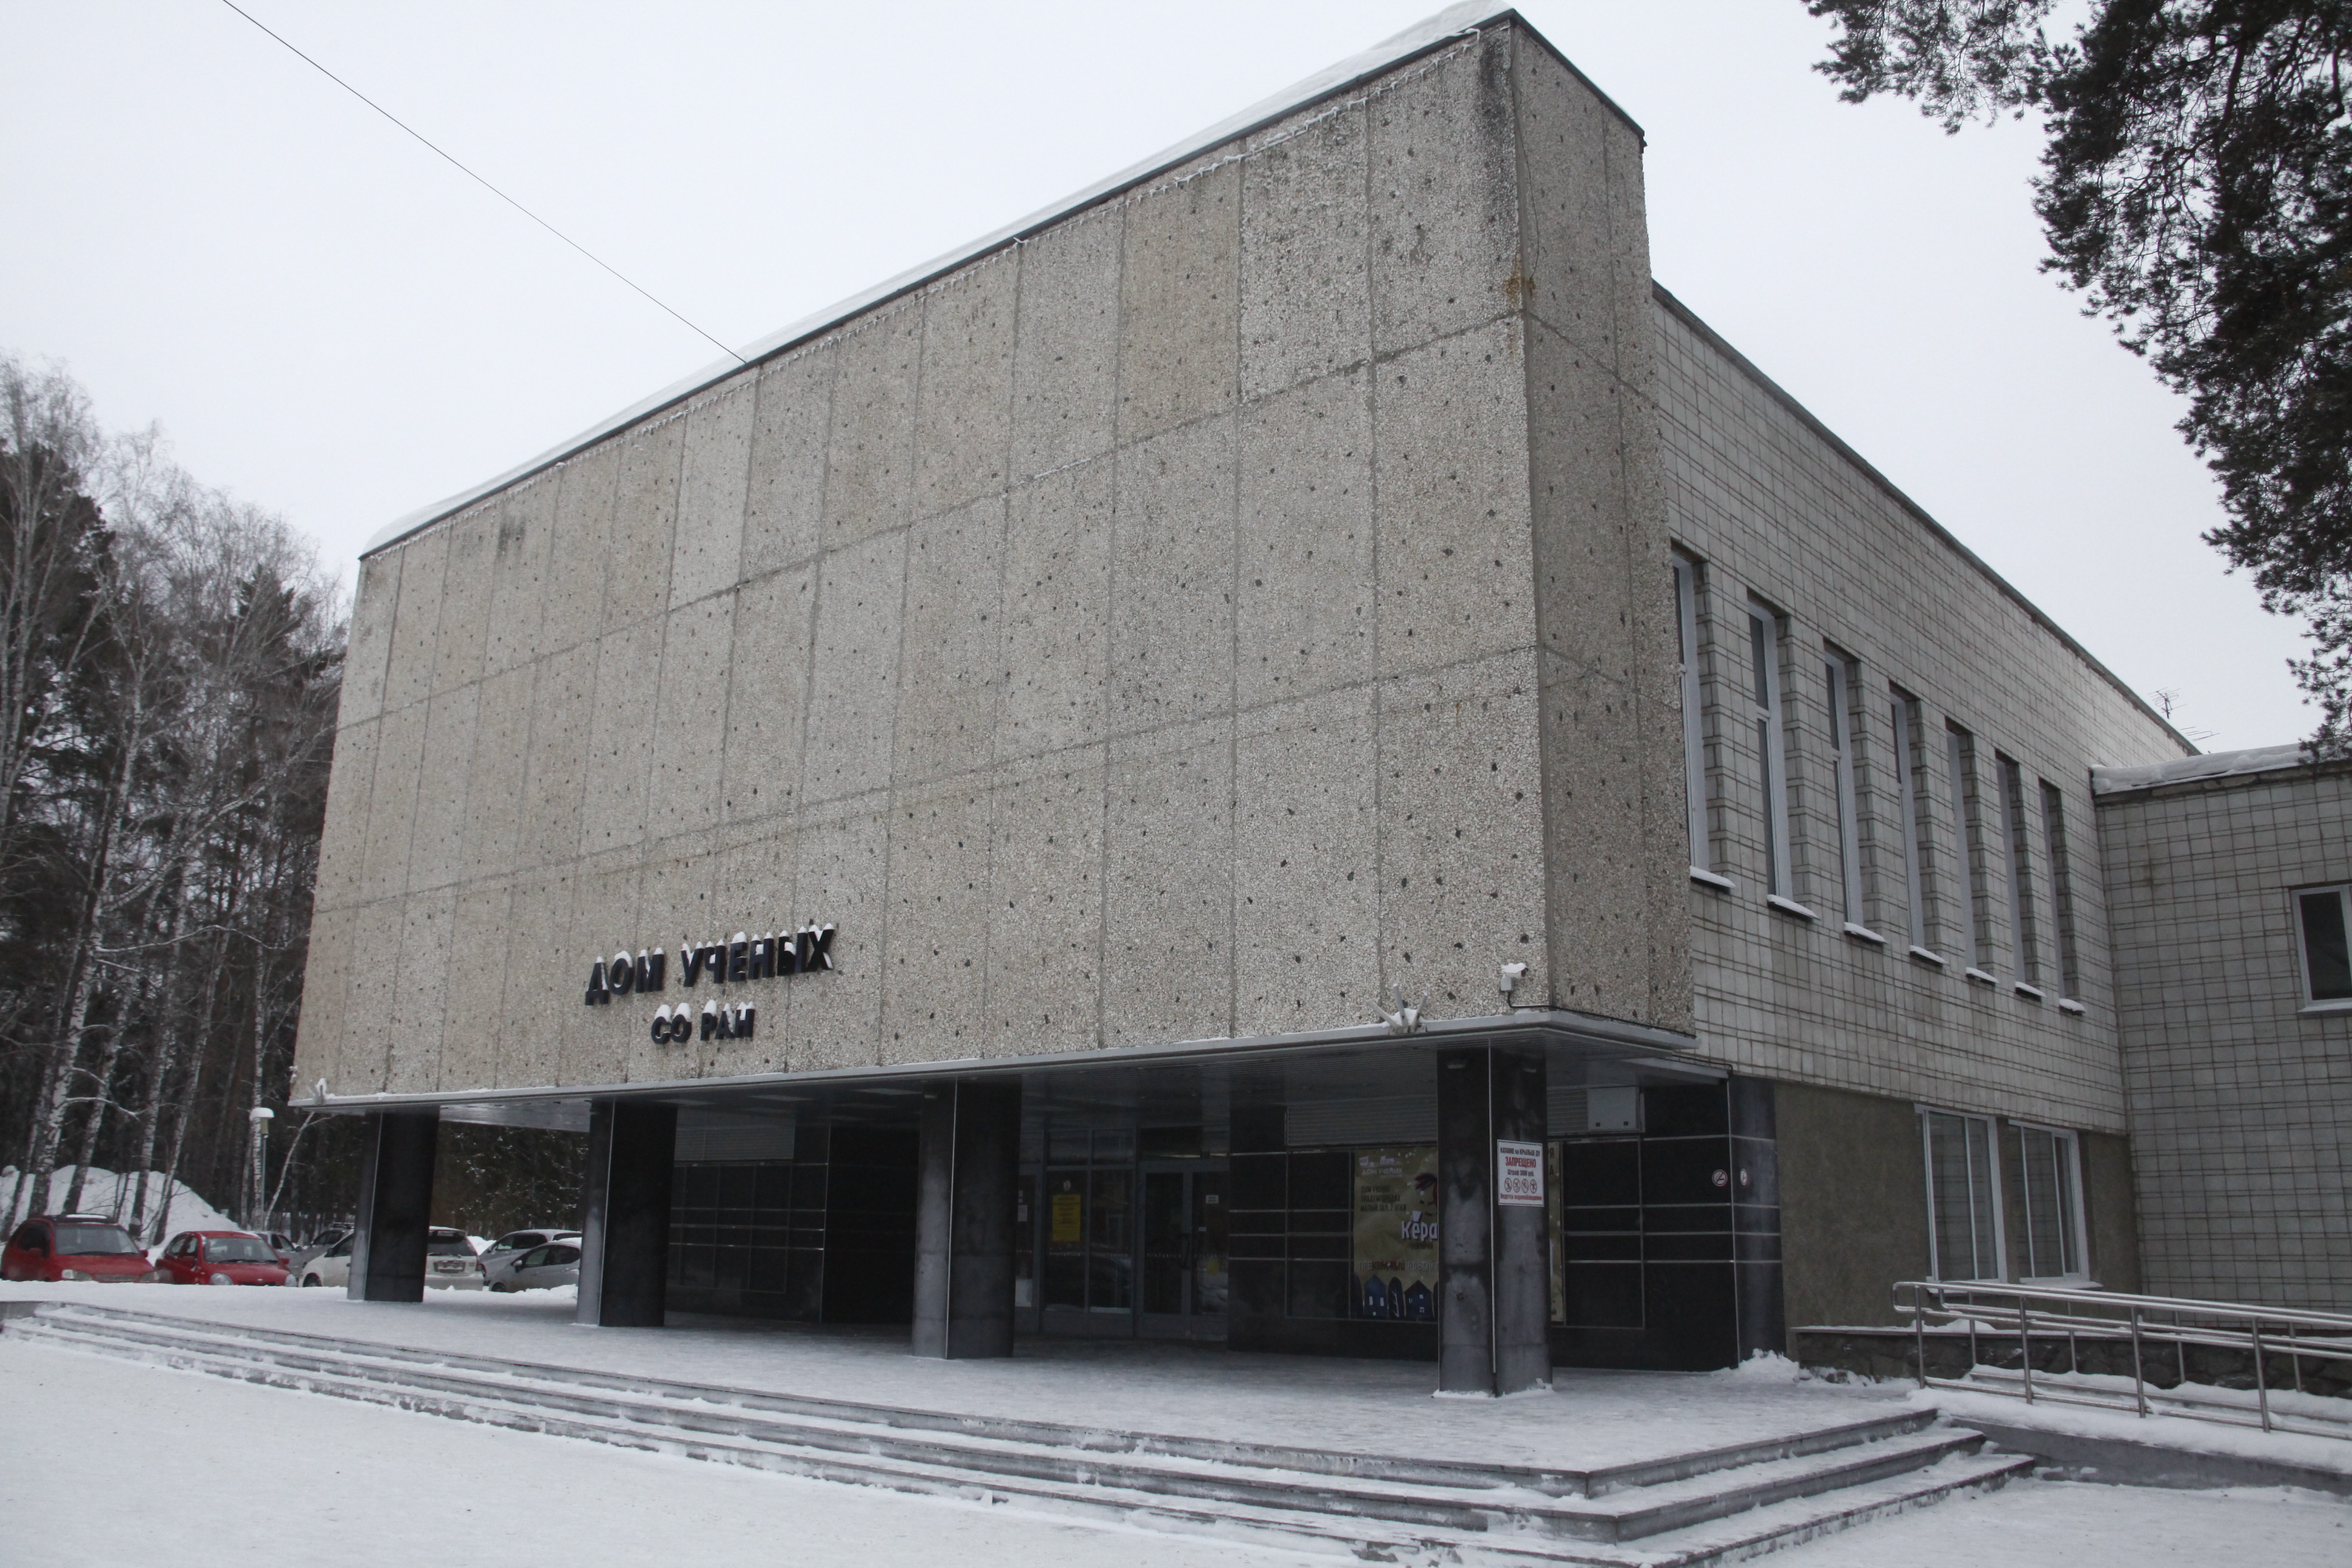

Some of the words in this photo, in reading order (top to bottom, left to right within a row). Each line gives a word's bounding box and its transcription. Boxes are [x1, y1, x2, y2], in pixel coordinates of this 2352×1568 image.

[585, 950, 665, 1005] ДОМ
[680, 927, 835, 987] УЧЕНЫХ
[651, 1012, 692, 1045] СО
[700, 1007, 755, 1041] РАН
[1505, 1156, 1536, 1168] ЗАПРЕЩЕНО
[1360, 1194, 1400, 1203] АКАДЕМГОРОДКА
[1360, 1203, 1378, 1211] МАЛЫЙ
